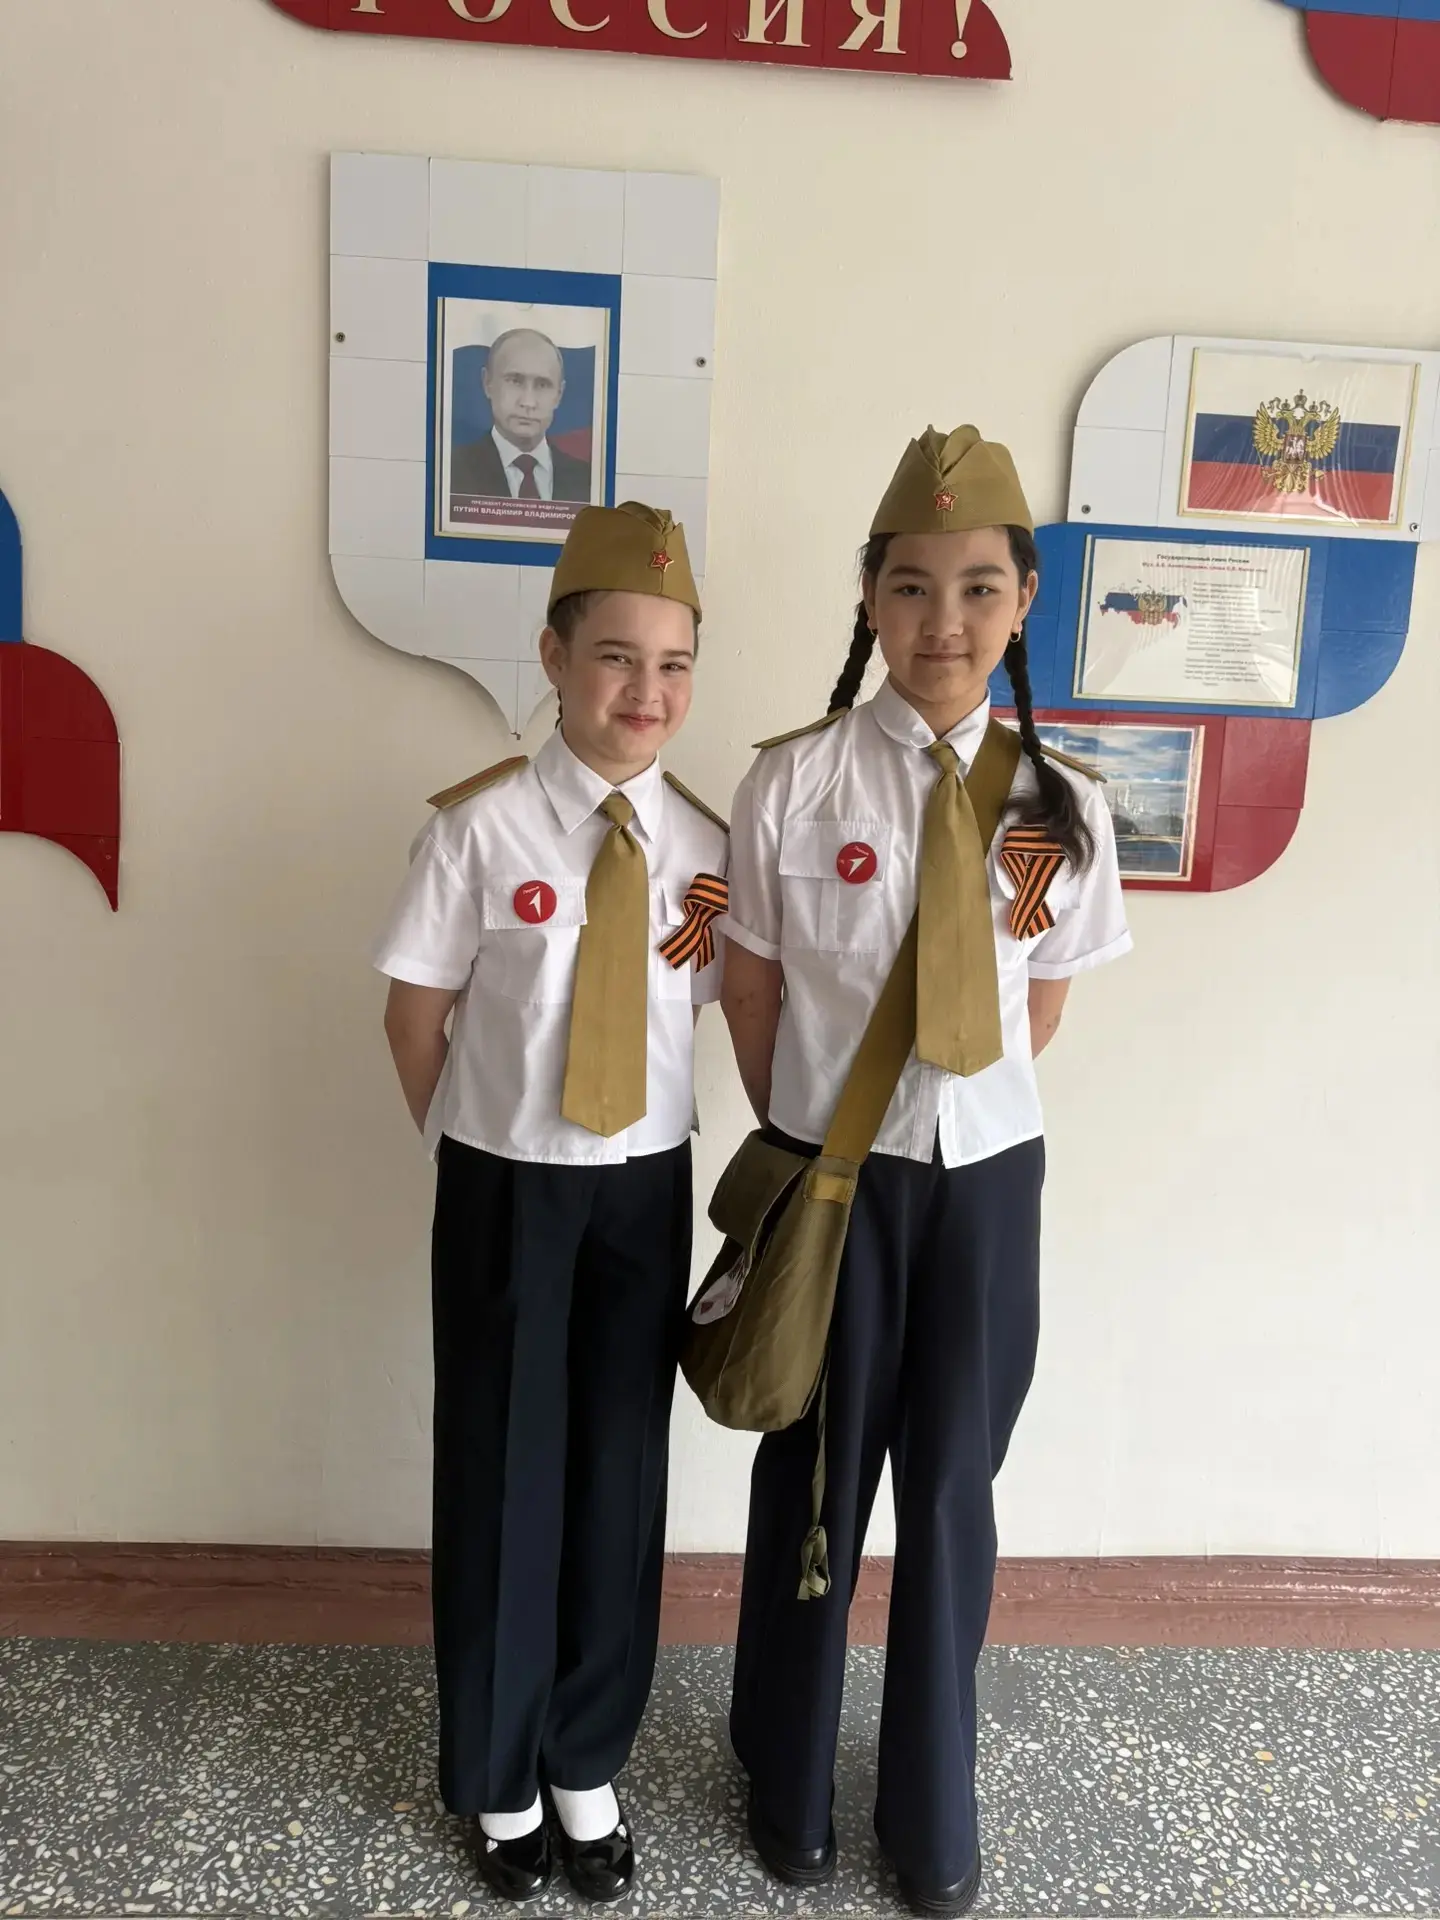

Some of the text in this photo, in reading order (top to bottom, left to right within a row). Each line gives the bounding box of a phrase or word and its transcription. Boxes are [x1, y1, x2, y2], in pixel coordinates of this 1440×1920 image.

[350, 0, 972, 59] ССИЯ!
[453, 505, 577, 520] ПУТИН ВЛАДИМИР ВЛАДИМИРОВ
